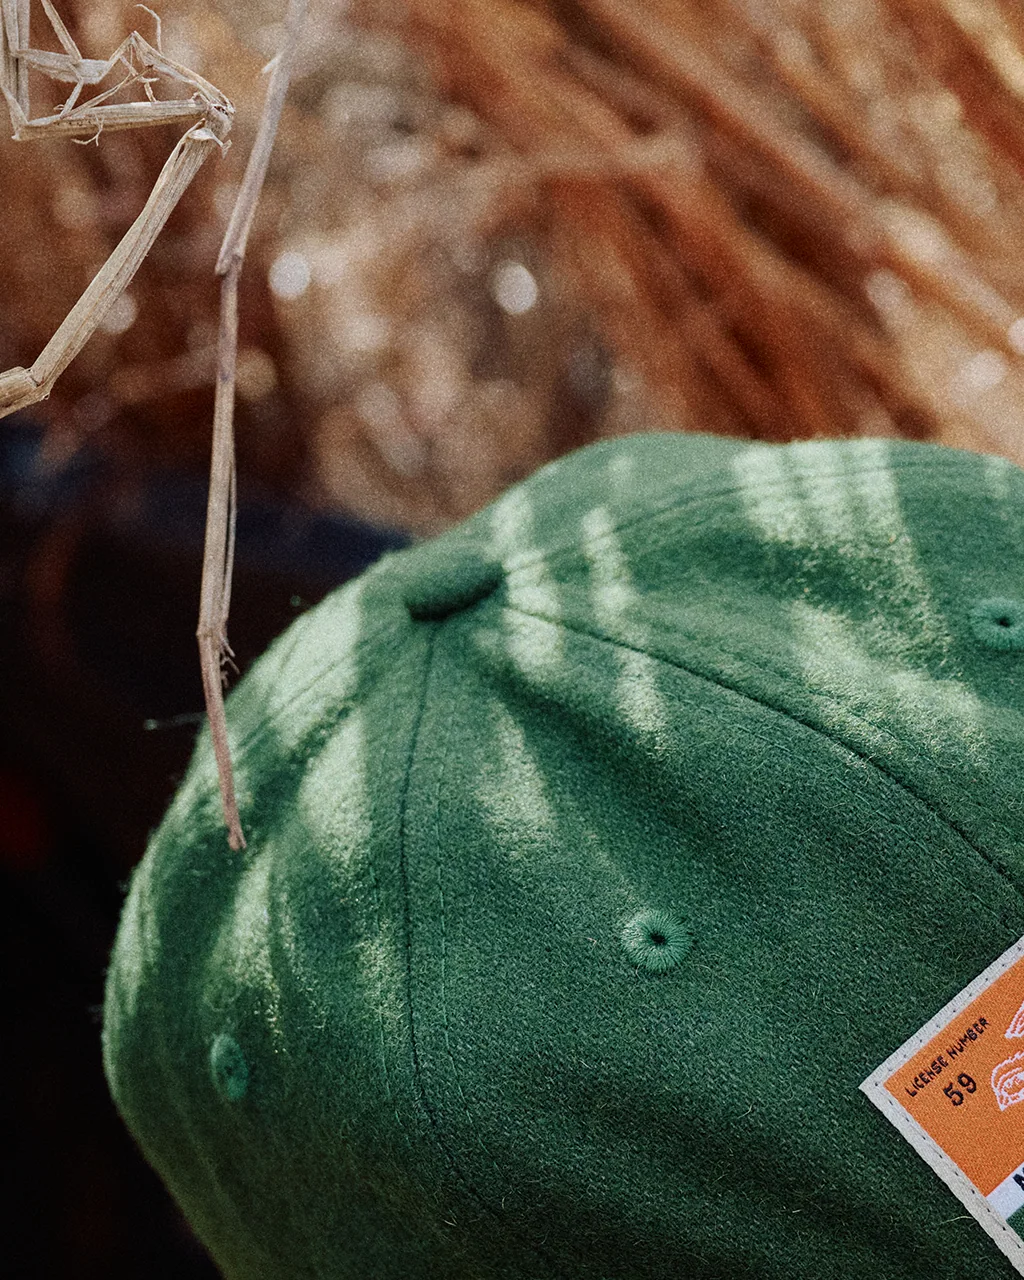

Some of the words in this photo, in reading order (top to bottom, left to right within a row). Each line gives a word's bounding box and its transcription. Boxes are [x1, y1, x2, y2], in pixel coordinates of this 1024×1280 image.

[904, 1056, 949, 1097] LICENSE
[946, 1017, 991, 1060] NUMBER
[943, 1072, 977, 1106] 59
